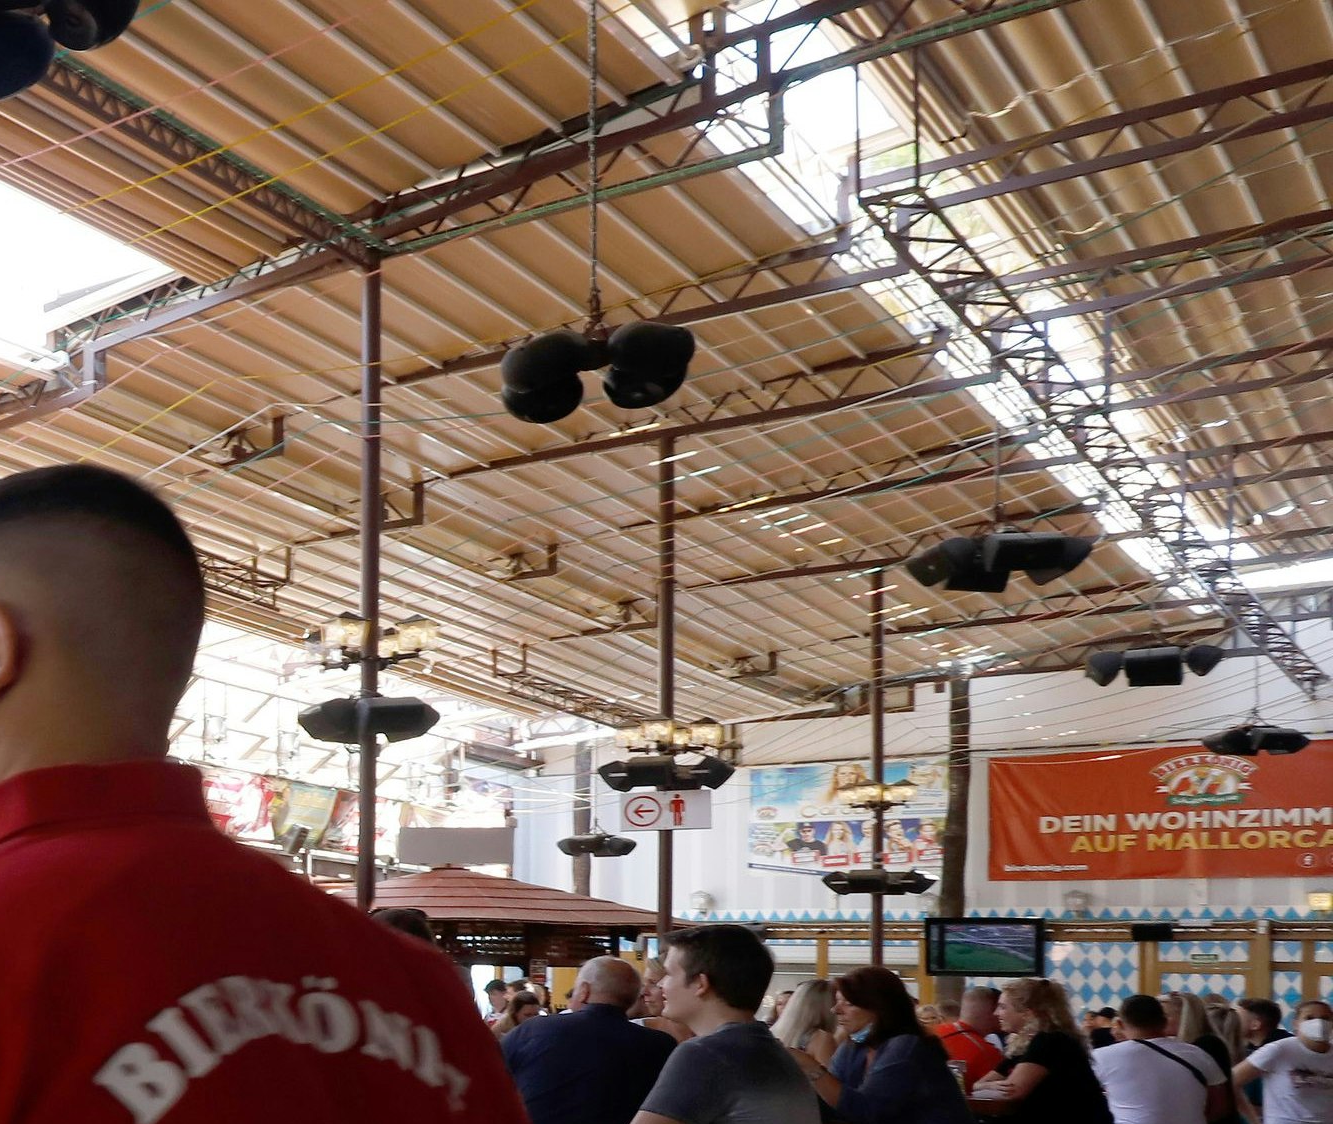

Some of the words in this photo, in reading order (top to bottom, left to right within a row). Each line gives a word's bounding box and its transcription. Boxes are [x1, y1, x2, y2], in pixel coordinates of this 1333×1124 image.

[1039, 813, 1117, 834] DEIN
[1124, 806, 1333, 832] WOHNZIMM
[1070, 833, 1137, 853] AUF
